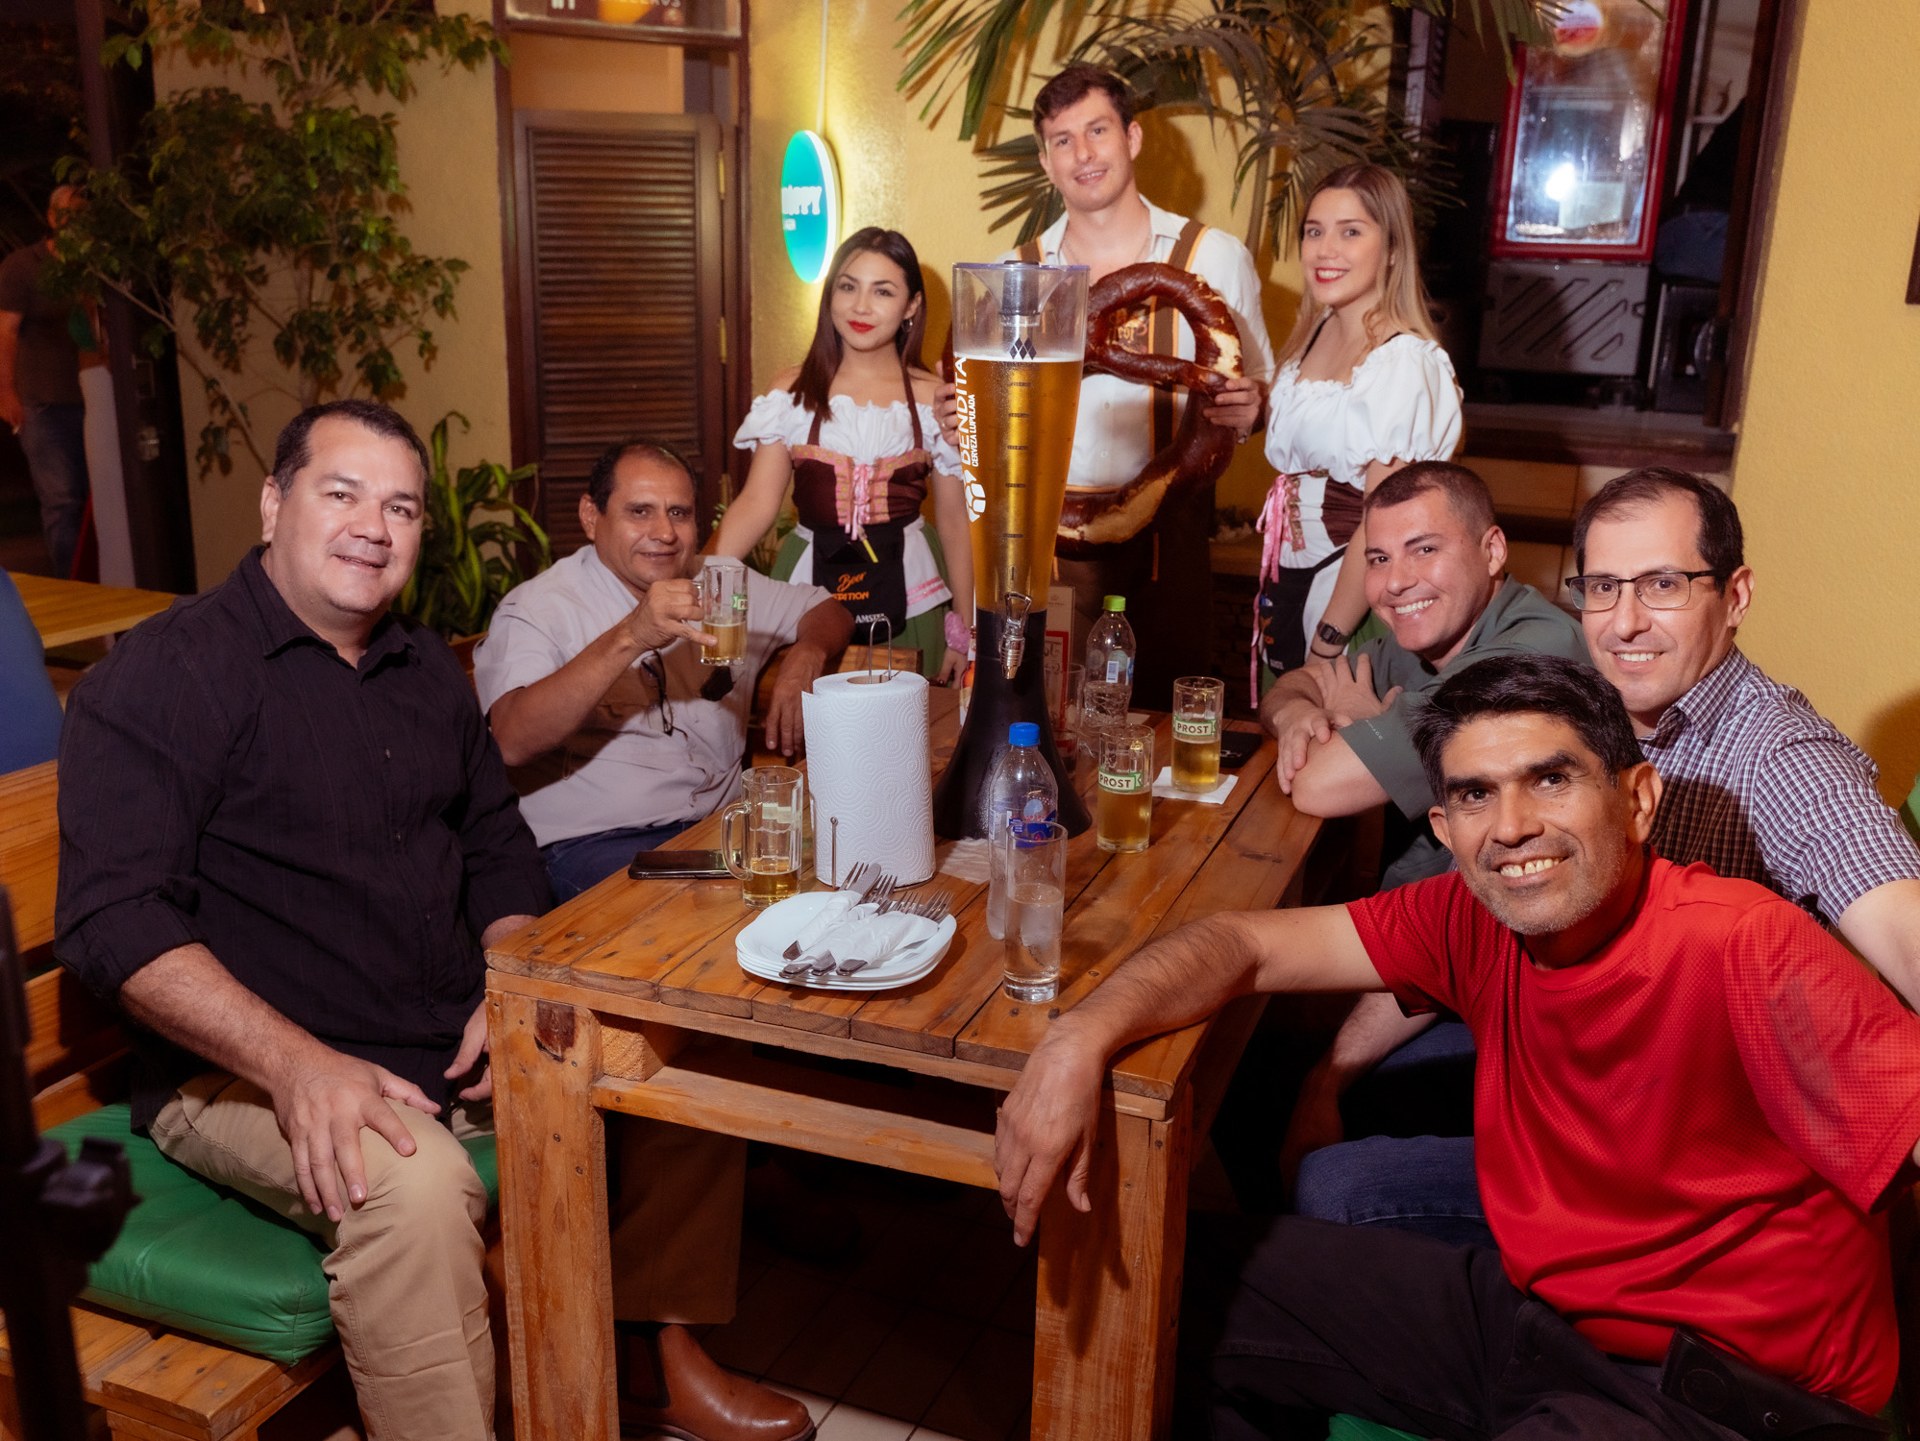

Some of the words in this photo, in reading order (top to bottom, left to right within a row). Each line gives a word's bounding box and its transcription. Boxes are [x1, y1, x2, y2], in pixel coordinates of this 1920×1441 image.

[968, 394, 976, 433] LUPULADA
[969, 434, 978, 467] CERVEZA
[836, 572, 866, 592] Beer
[1177, 722, 1209, 734] PROST
[1099, 774, 1132, 788] PROST
